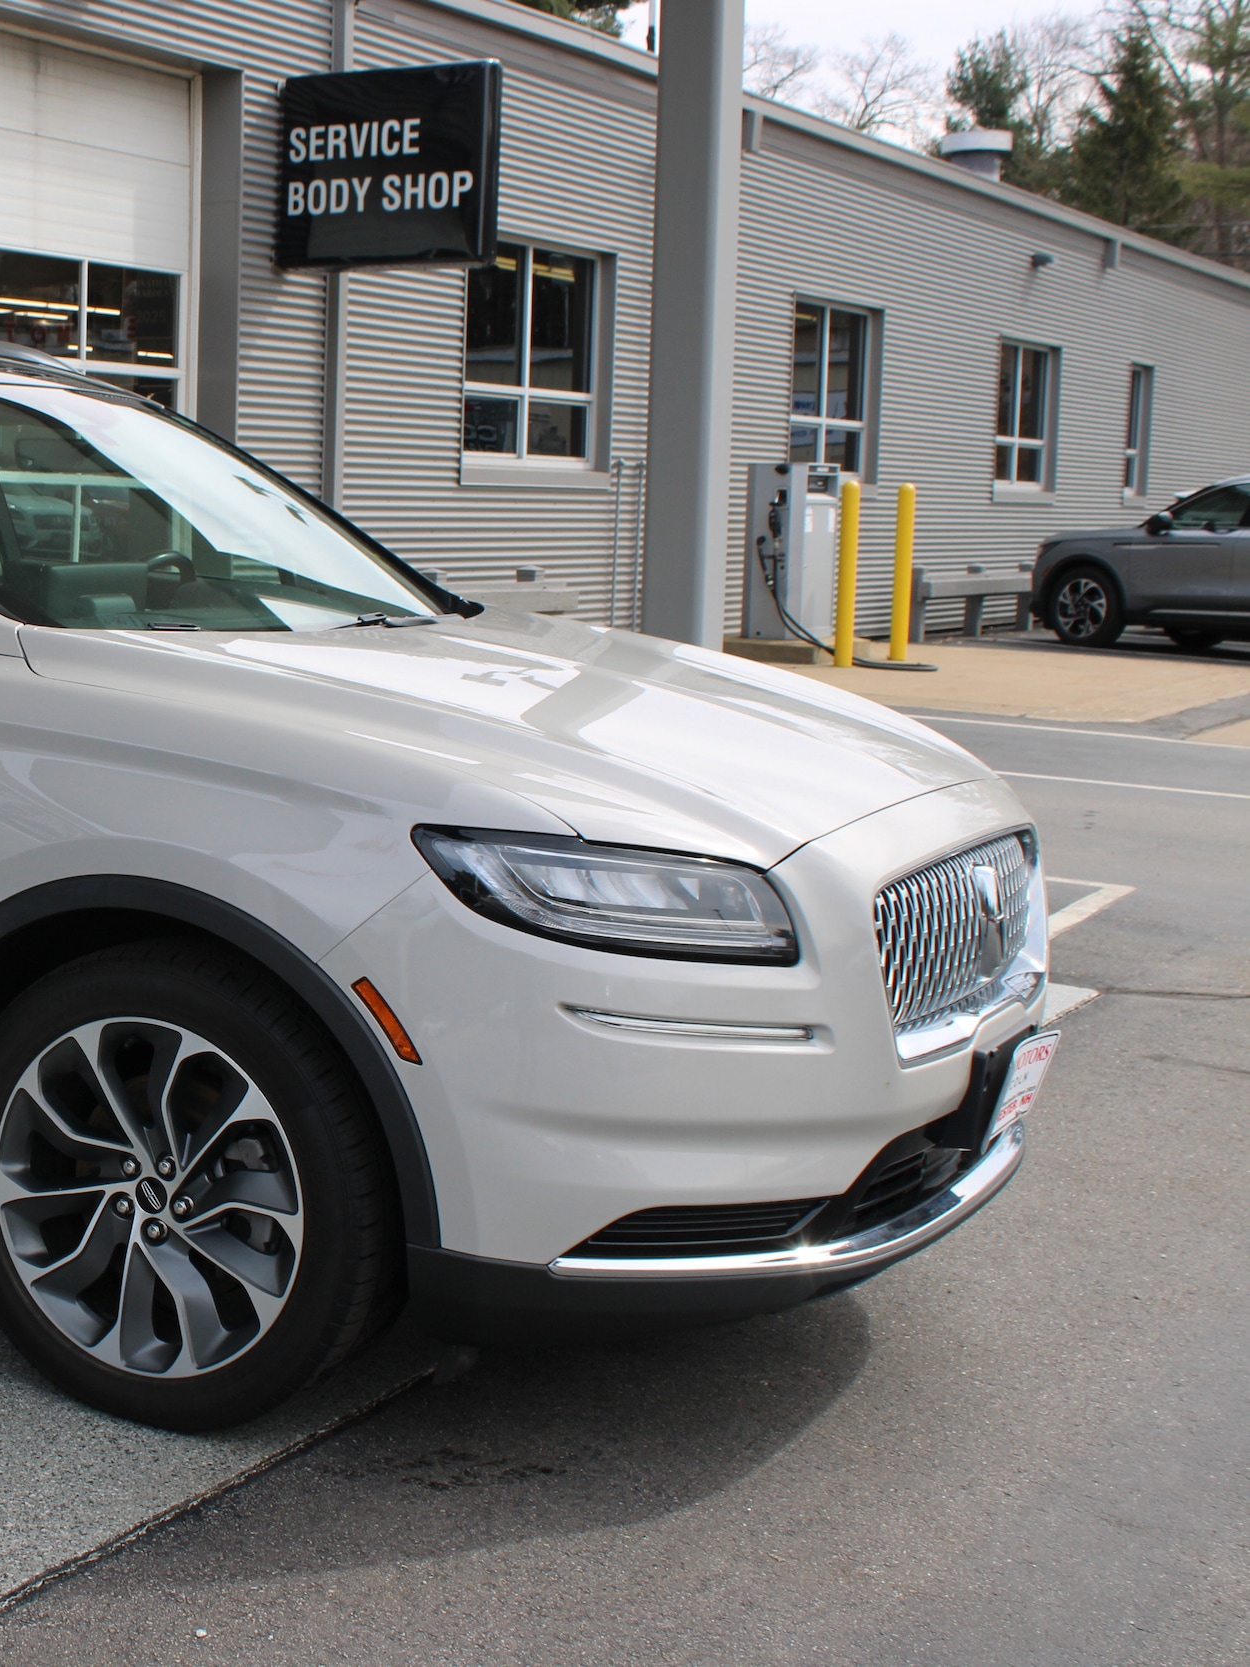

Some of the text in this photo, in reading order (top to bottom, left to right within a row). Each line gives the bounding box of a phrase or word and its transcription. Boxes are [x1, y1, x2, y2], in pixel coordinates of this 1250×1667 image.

[289, 118, 421, 163] SERVICE
[287, 170, 474, 216] BODY SHOP
